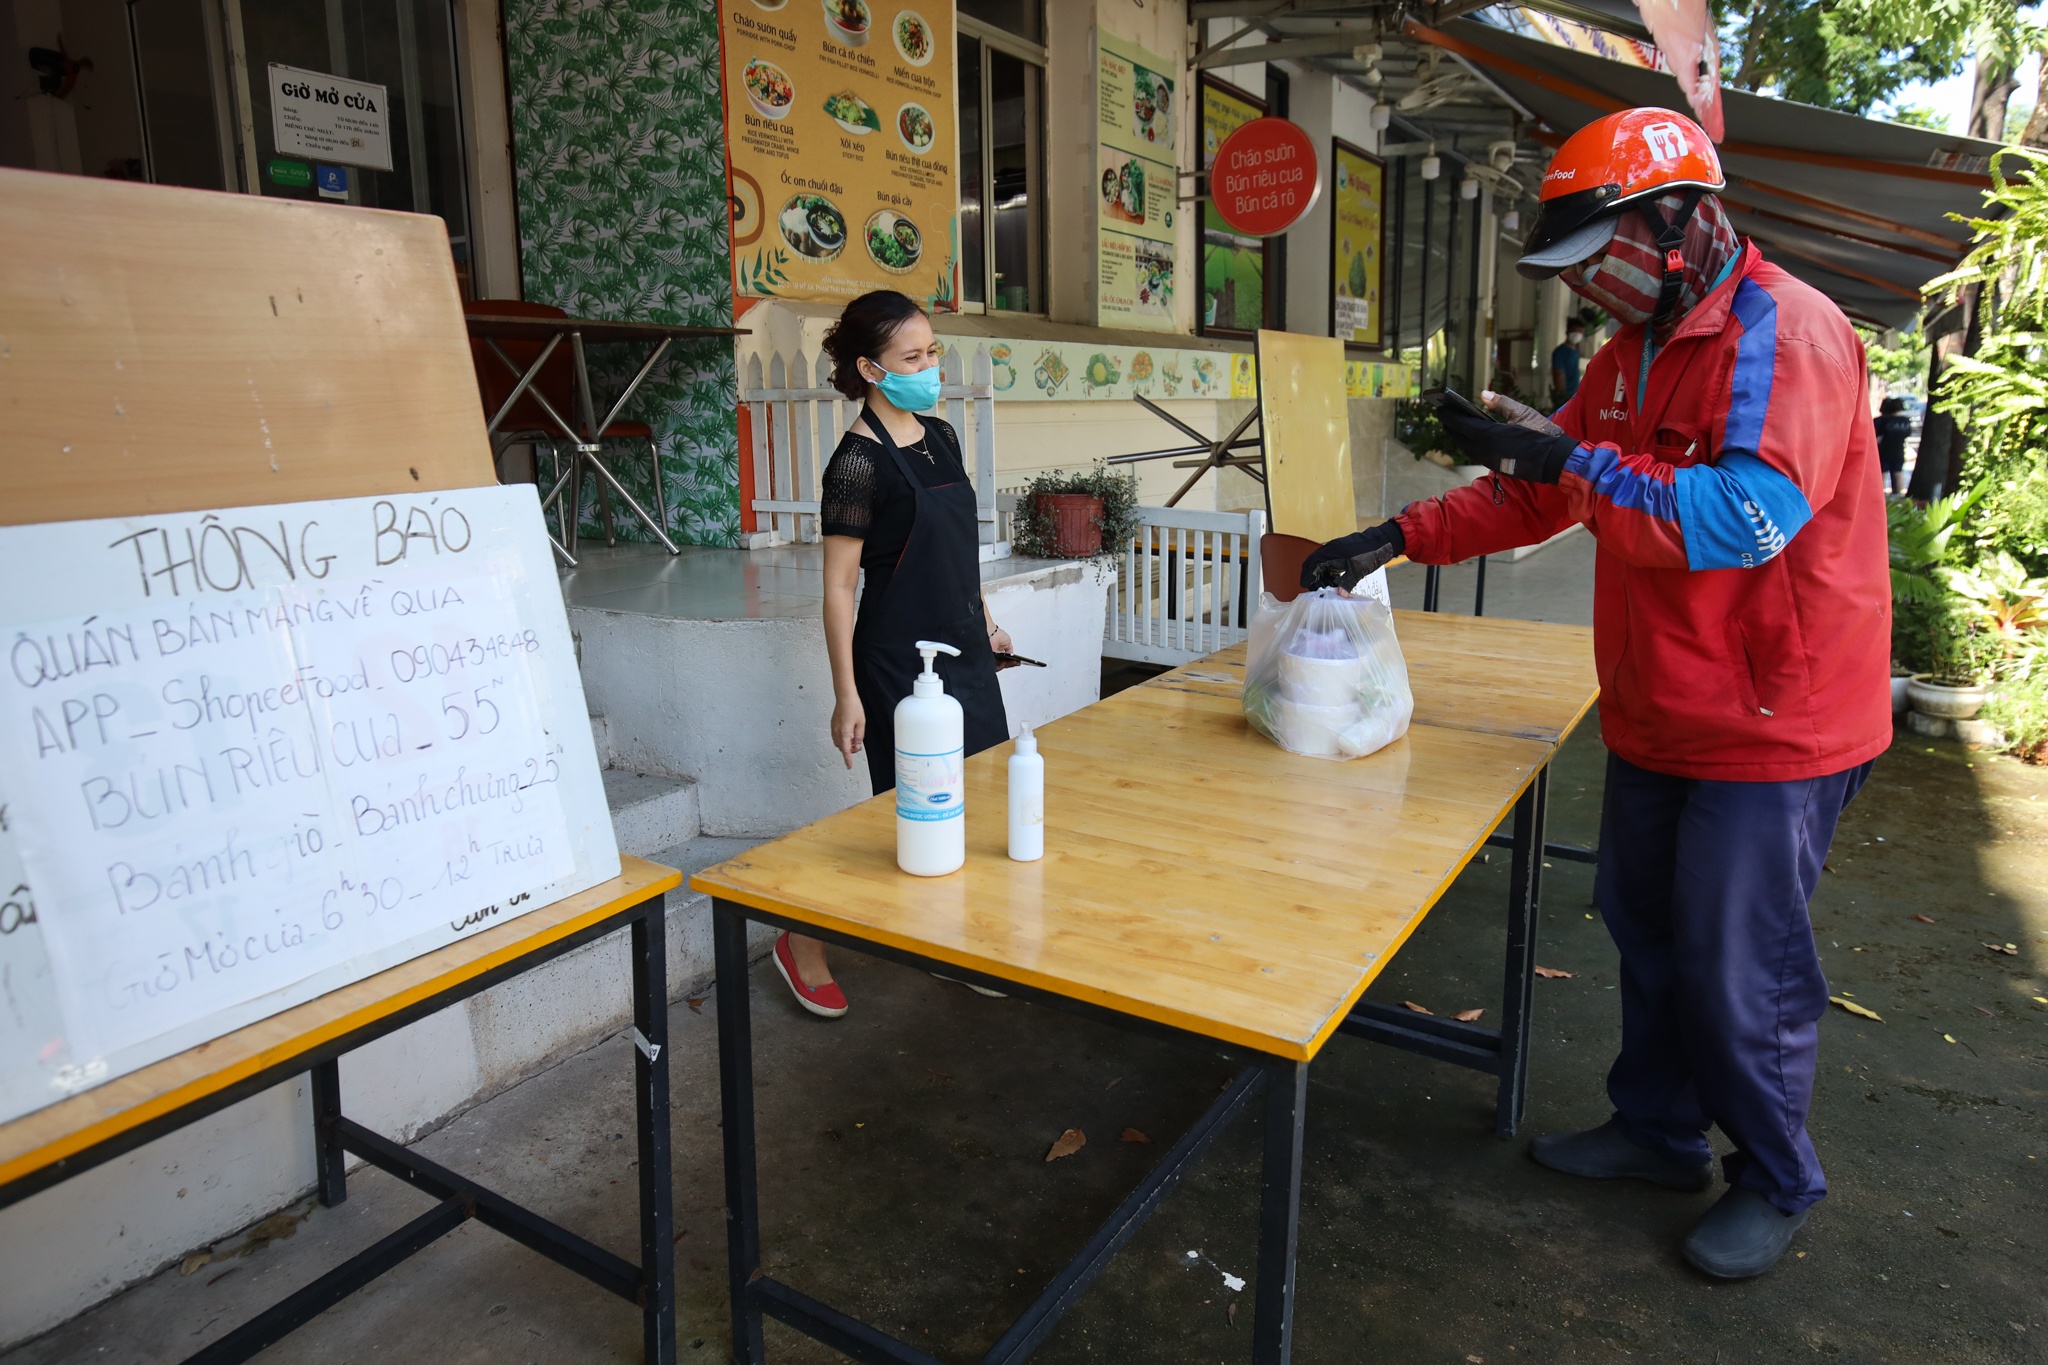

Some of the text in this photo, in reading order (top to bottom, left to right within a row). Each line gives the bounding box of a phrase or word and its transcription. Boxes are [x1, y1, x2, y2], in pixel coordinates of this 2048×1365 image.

[734, 12, 754, 28] Cháo
[760, 36, 770, 44] WITH
[823, 41, 836, 54] Bún
[838, 48, 846, 58] cá
[857, 52, 876, 67] chiên
[911, 72, 922, 82] cua
[314, 87, 339, 105] MỞ
[344, 92, 378, 113] CỬA
[284, 122, 302, 130] RIÊNG
[745, 114, 794, 136] Bún riêu cua
[748, 129, 758, 137] RICE
[754, 146, 766, 154] PORK
[766, 149, 776, 157] AND
[840, 138, 865, 152] Xôi xéo
[856, 154, 864, 162] RICE
[886, 150, 898, 161] Bún
[922, 160, 932, 170] cua
[1231, 148, 1262, 170] Cháo
[290, 168, 306, 177] Grab
[780, 169, 792, 184] Ốc
[794, 177, 806, 186] om
[829, 182, 843, 196] đậu
[1226, 167, 1303, 194] Bún riêu cua
[878, 190, 890, 202] Bún
[1236, 188, 1295, 214] Bún cá rô
[109, 497, 471, 597] THÔNG BÁO
[11, 579, 465, 688] QUÁN BÁN MANG VỀ QUA
[32, 693, 120, 758] APP
[162, 657, 370, 733] ShopeeFood
[219, 728, 321, 794] RIÊU
[351, 773, 441, 836] Bánh
